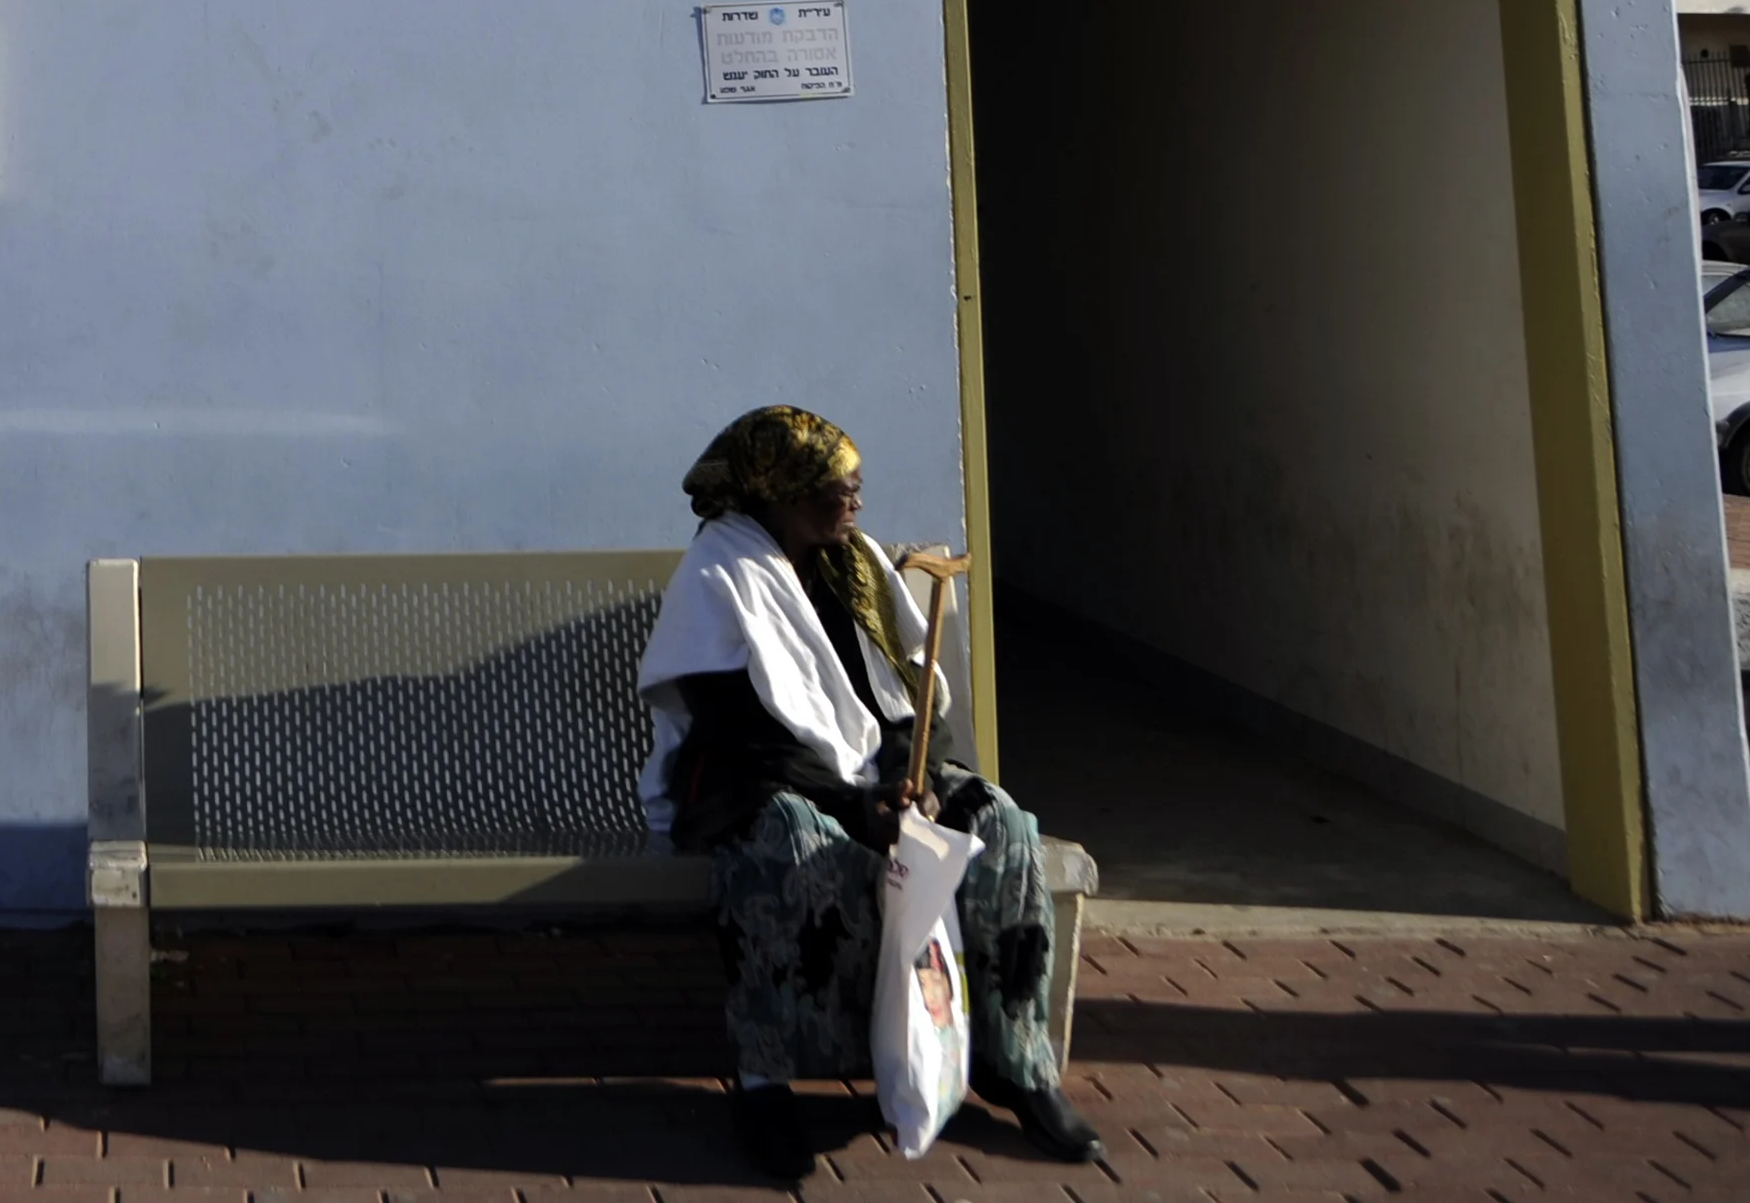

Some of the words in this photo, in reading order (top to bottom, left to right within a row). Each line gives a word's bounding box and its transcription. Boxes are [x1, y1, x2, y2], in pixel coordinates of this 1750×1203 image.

[722, 10, 758, 22] שדרות
[717, 31, 773, 46] מודעות
[782, 27, 838, 43] הדבקת
[721, 47, 779, 64] בהחלט
[787, 47, 836, 61] אסורה
[754, 69, 779, 80] החוק
[784, 67, 800, 77] על
[806, 66, 838, 77] העובר
